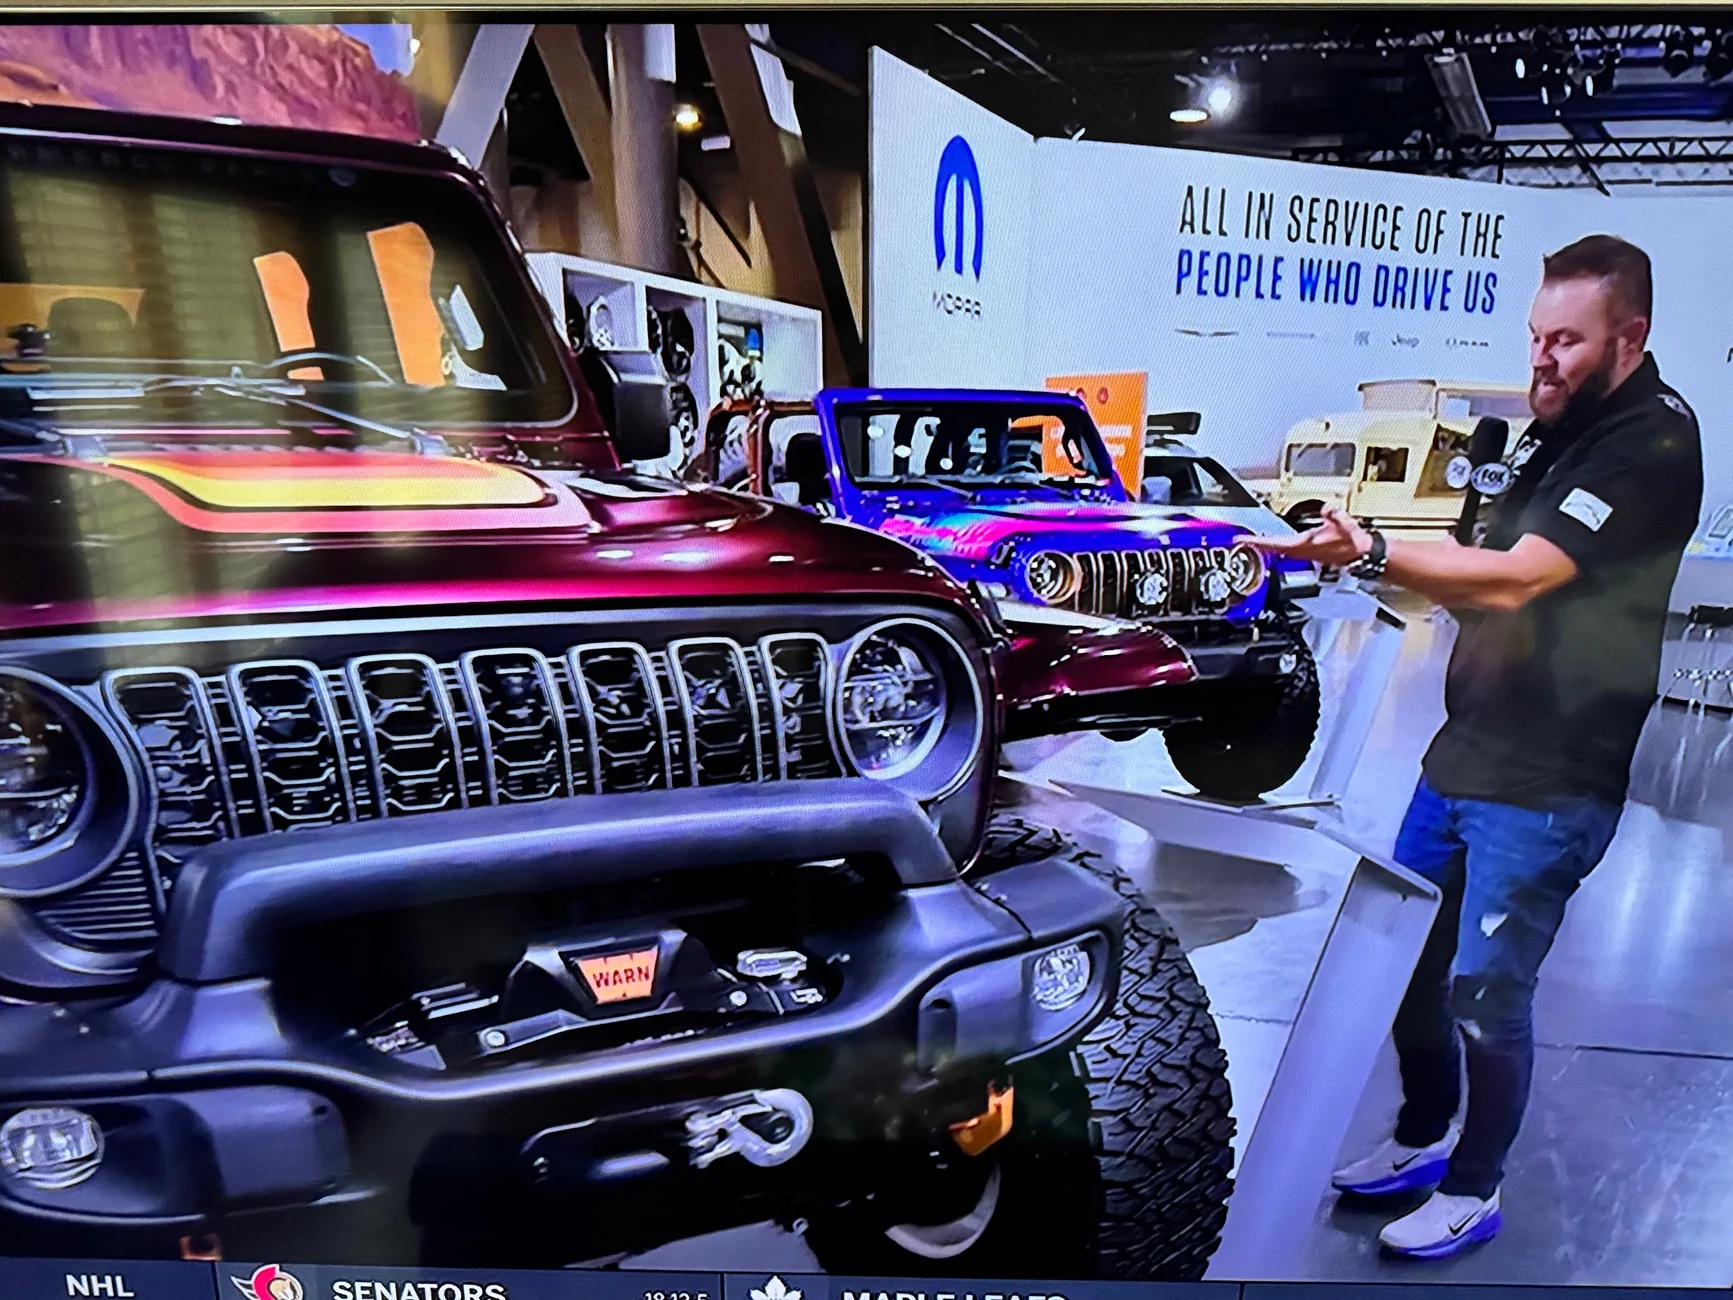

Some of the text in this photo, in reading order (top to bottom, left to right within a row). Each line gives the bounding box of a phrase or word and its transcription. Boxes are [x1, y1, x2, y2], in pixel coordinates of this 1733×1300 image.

[1179, 185, 1505, 259] ALL IN SERVICE OF THE
[1176, 248, 1498, 314] PEOPLE WHO DRIVE US
[592, 965, 650, 989] WARN
[65, 1274, 135, 1298] NHL
[332, 1281, 506, 1300] SENATORS
